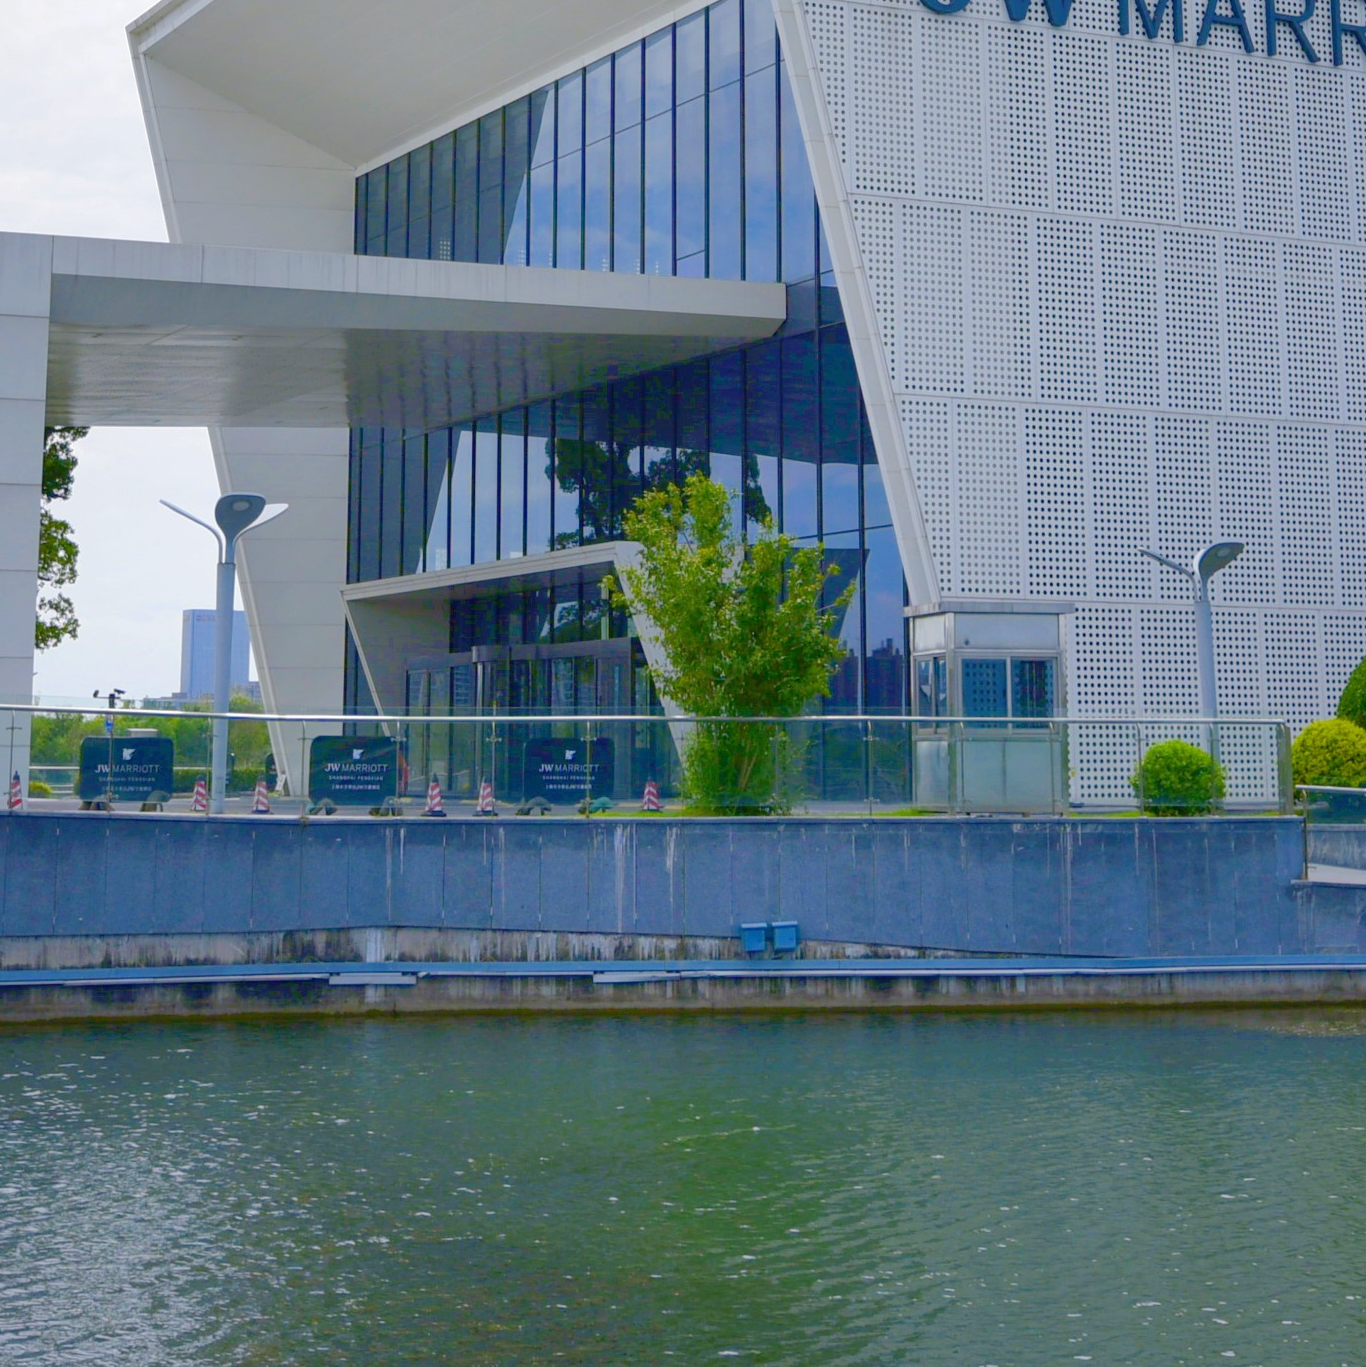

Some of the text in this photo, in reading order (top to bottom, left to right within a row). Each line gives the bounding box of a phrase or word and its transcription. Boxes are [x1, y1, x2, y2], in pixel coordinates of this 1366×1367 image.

[95, 764, 160, 773] JW MARRIOTT
[325, 763, 388, 773] JW MARRIOTT
[539, 764, 600, 773] JW MARRIOTT
